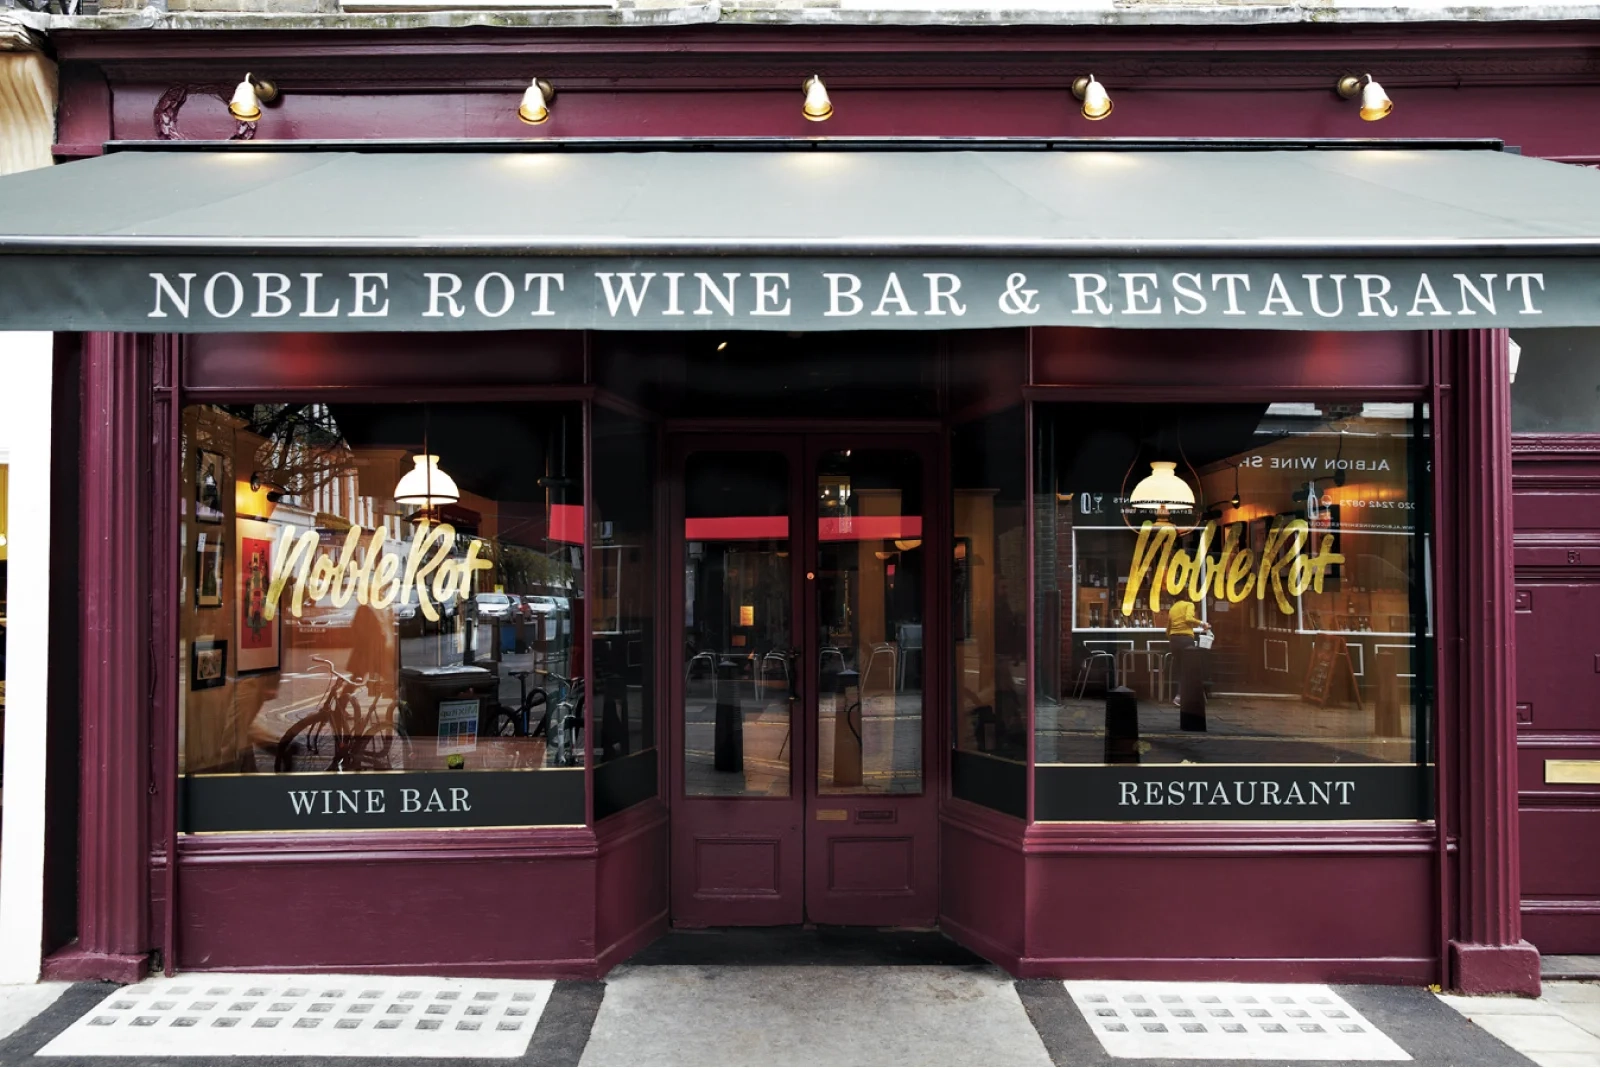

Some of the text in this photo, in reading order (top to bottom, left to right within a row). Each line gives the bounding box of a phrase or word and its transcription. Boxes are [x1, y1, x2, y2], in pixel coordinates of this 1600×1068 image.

[148, 271, 1546, 319] NOBLE ROT WINE BAR & RESTAURANT
[287, 787, 472, 815] WINE BAR
[1118, 780, 1356, 806] RESTAURANT
